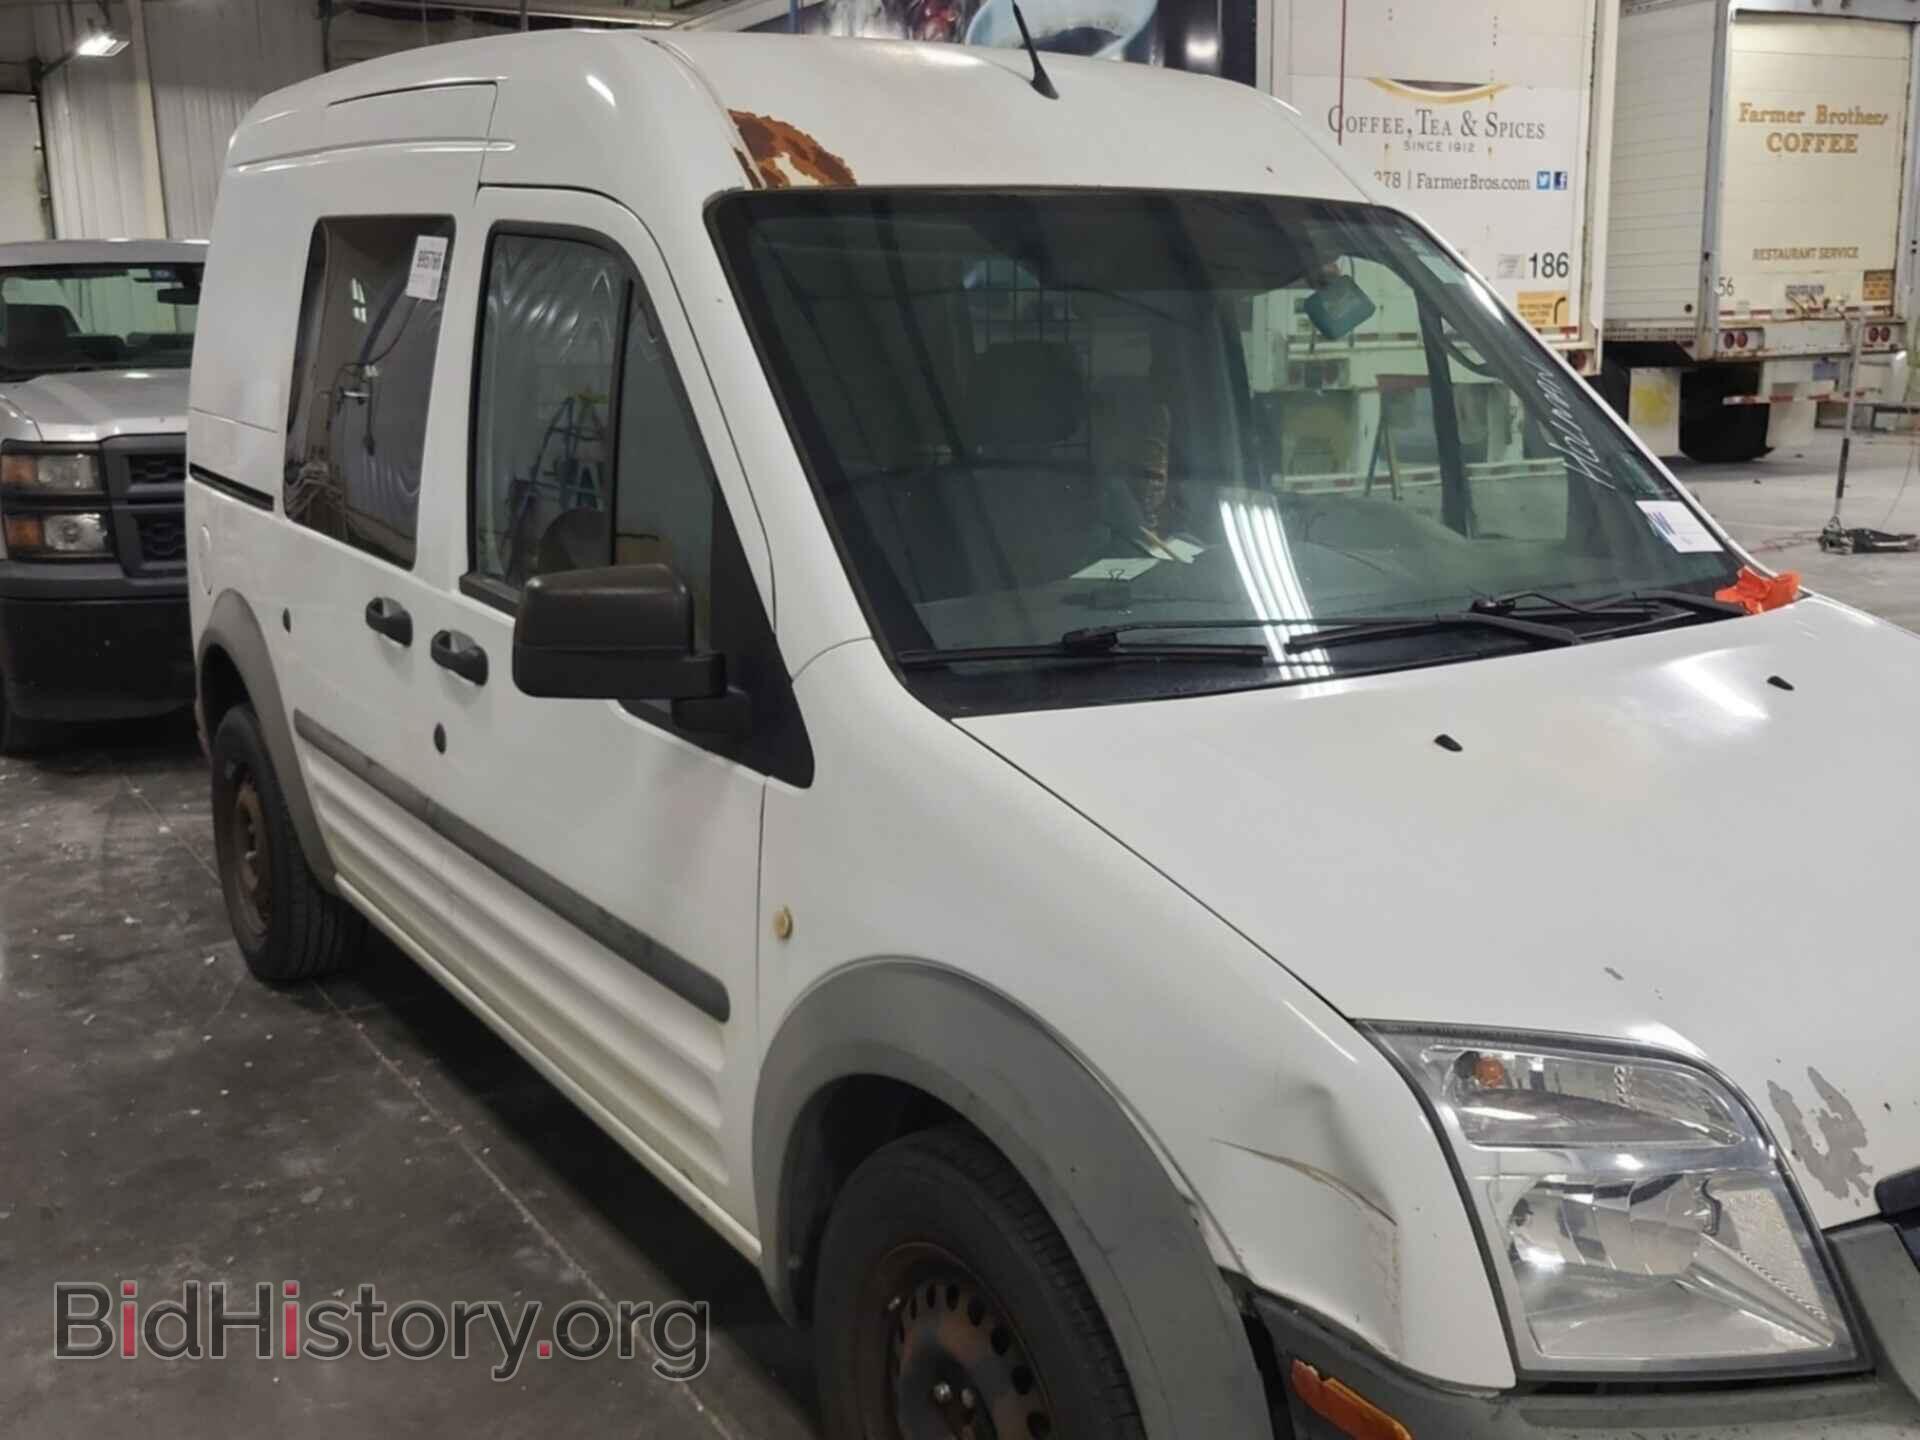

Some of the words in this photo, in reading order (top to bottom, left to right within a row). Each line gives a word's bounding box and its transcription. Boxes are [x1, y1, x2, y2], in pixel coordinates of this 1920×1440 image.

[1415, 108, 1453, 137] TEA
[1460, 110, 1478, 138] &
[1484, 111, 1546, 140] SPICES
[1738, 102, 1806, 124] Farmer
[1815, 104, 1889, 126] Brothers
[1403, 141, 1443, 152] SINCE
[1448, 142, 1475, 153] 1912
[1766, 132, 1859, 154] COFFEE
[1416, 172, 1531, 191] FarmerBros.com
[1752, 247, 1817, 261] RESTAURANT
[1818, 246, 1859, 259] SERVICE
[1528, 251, 1569, 279] 186
